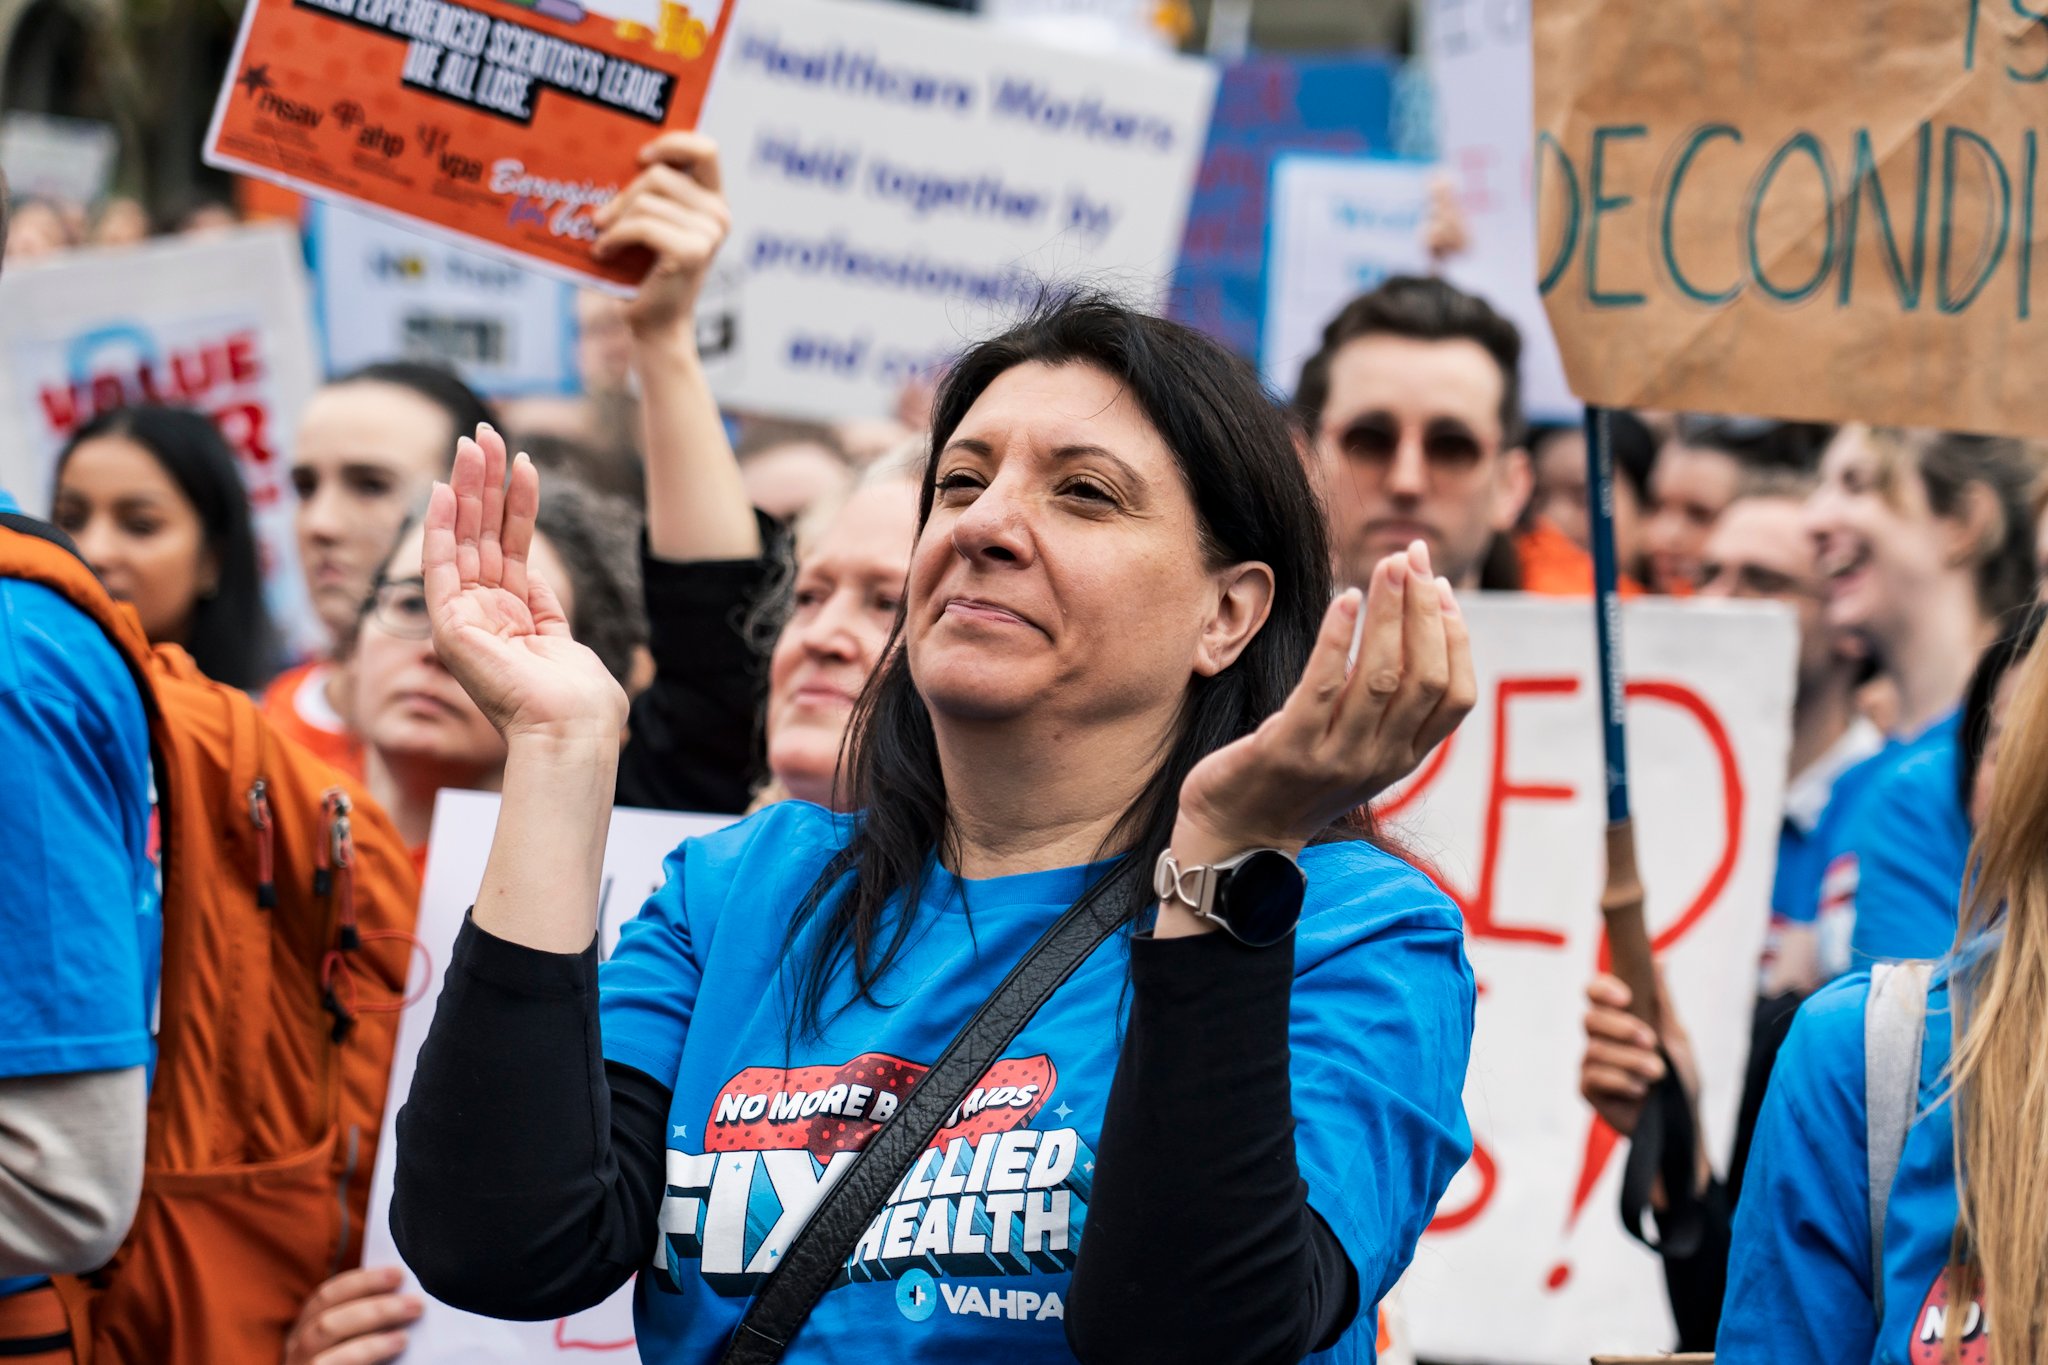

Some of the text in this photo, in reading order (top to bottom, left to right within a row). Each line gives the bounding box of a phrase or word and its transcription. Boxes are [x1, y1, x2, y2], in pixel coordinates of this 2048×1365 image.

[354, 0, 491, 56] EXPERIENCED
[484, 19, 606, 95] SCIENTISTS
[403, 40, 446, 86] WE
[438, 51, 480, 101] ALL
[258, 91, 324, 129] msav
[738, 32, 975, 112] Healthcare
[993, 76, 1177, 154] Workers
[357, 126, 406, 159] ahp
[438, 151, 483, 182] vpa
[489, 157, 619, 209] Bargaini
[756, 134, 1117, 240] Held together by
[714, 1092, 769, 1124] NO
[767, 1083, 873, 1121] MORE
[886, 1128, 1078, 1206] LLIED
[653, 1149, 862, 1274] FIX
[851, 1189, 1071, 1267] HEALTH
[940, 1283, 1064, 1321] VAHPA
